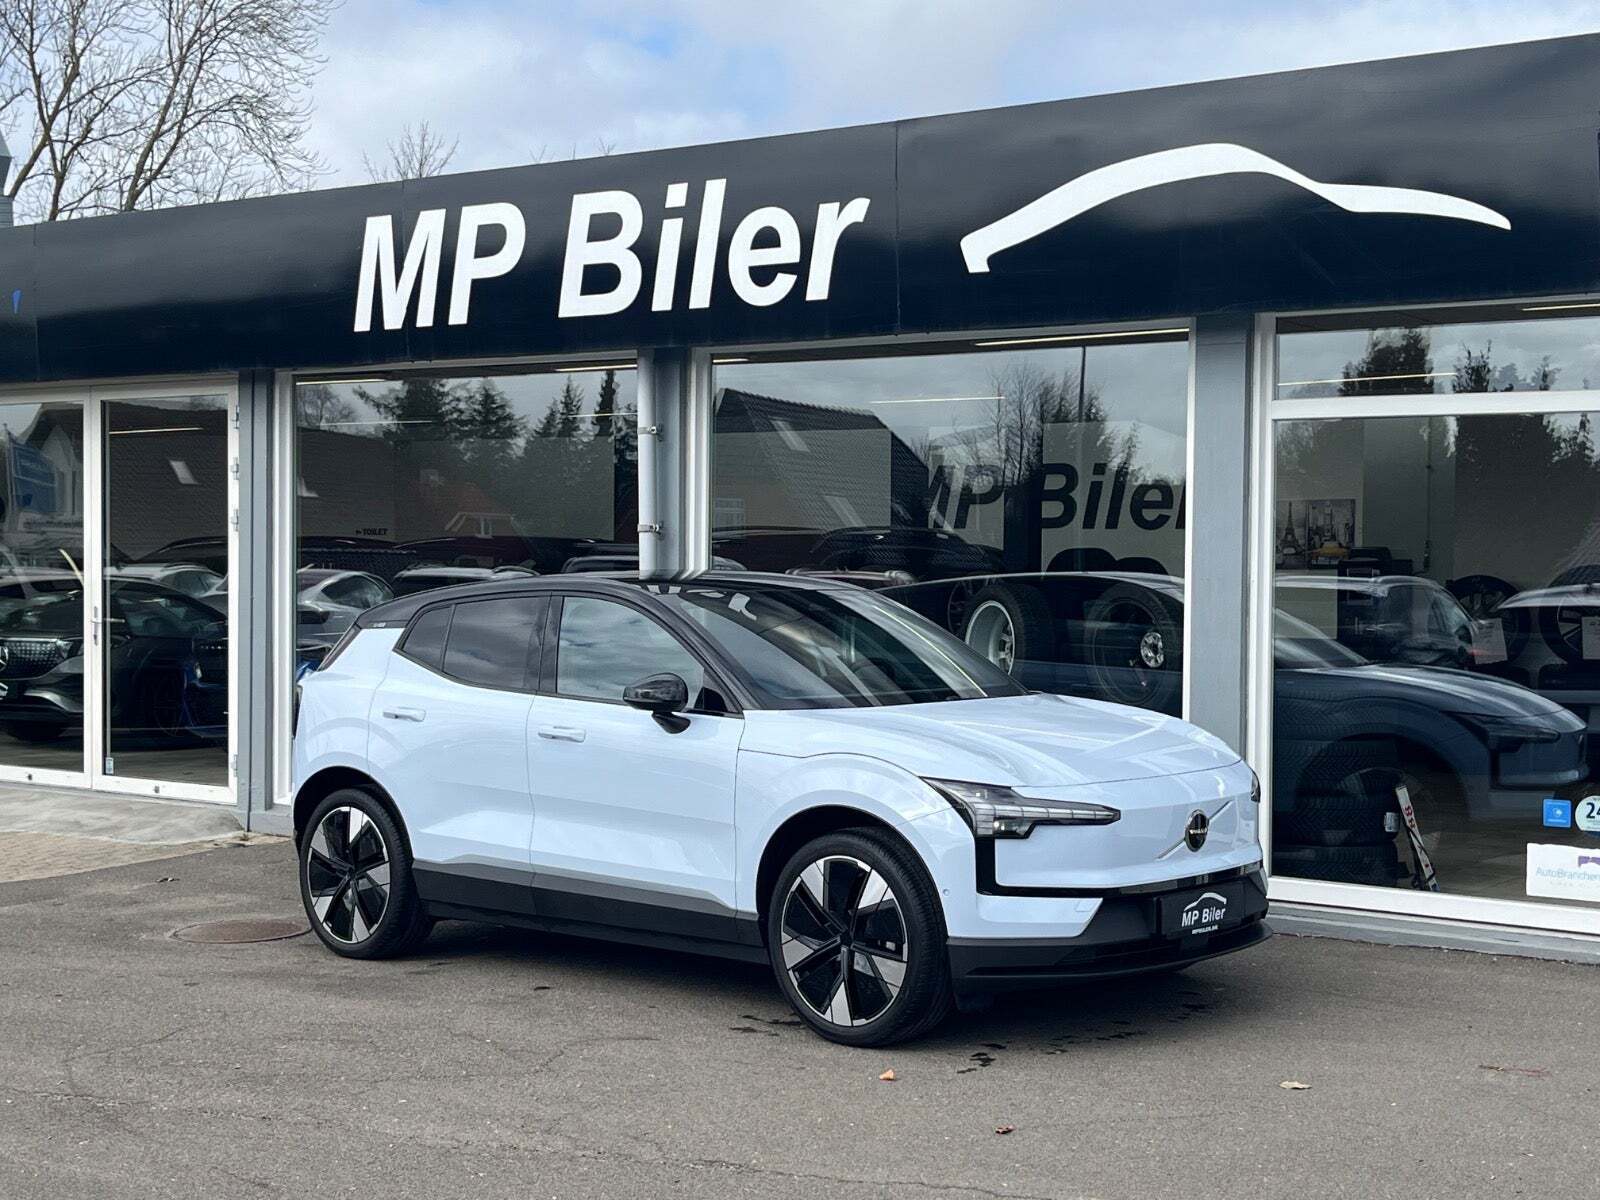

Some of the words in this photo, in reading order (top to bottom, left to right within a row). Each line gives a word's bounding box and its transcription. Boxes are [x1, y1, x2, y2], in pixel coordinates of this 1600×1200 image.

[353, 202, 526, 333] MP
[558, 178, 871, 318] Biler
[1041, 462, 1186, 531] Bile
[1181, 910, 1200, 928] MP
[1202, 905, 1226, 924] Biler
